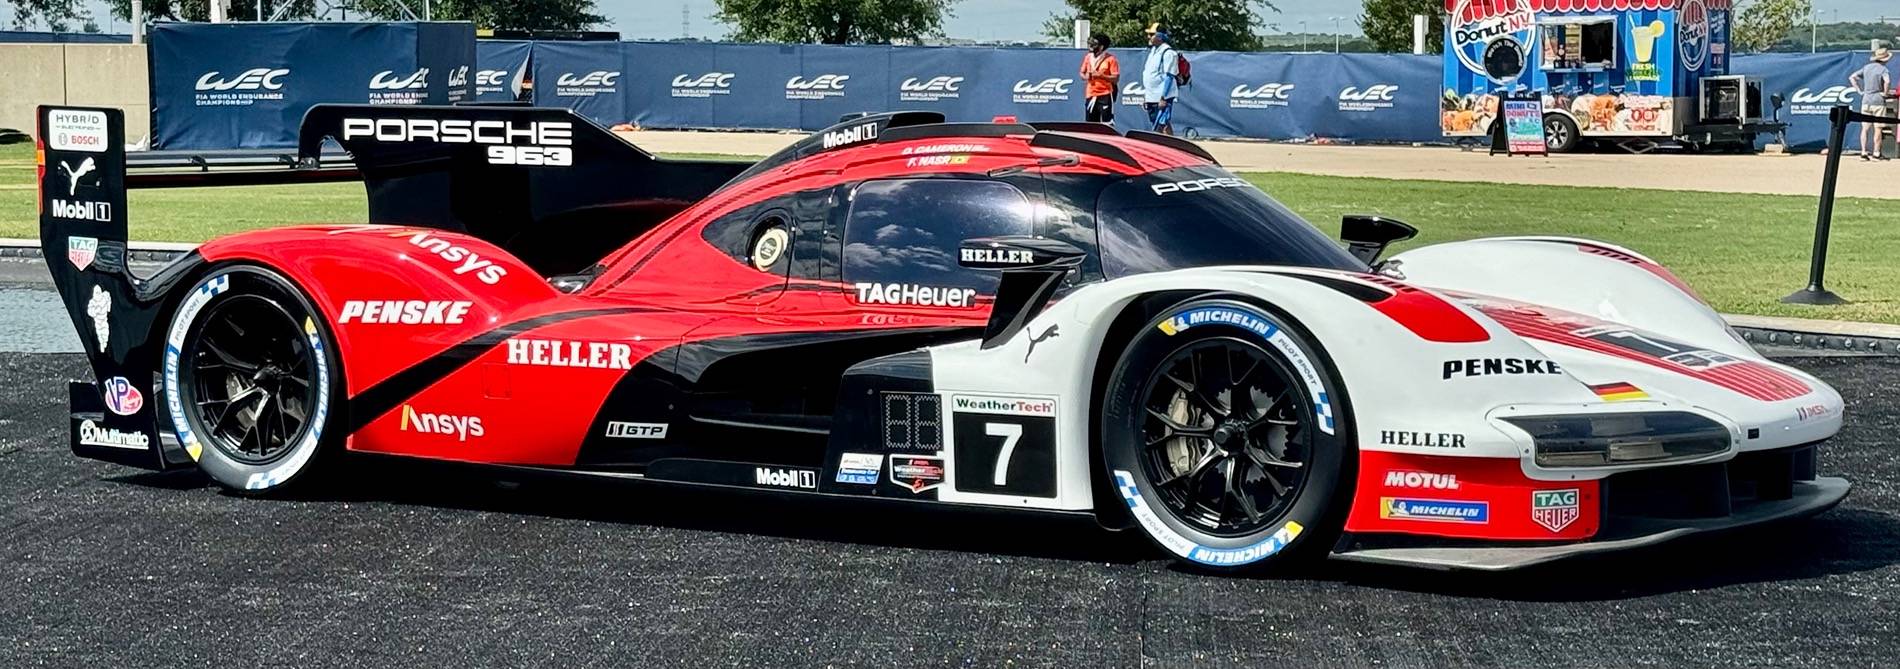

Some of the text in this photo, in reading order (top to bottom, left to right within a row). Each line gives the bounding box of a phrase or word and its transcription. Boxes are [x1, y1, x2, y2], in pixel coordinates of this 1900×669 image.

[1456, 22, 1508, 45] Donut
[195, 68, 290, 91] WEC
[475, 70, 508, 85] EC
[557, 71, 621, 86] WEC
[672, 72, 735, 87] WEC
[786, 74, 850, 90] WEC
[900, 76, 964, 91] WEC
[1013, 78, 1074, 94] WEC
[1230, 83, 1295, 99] WEC
[1339, 84, 1399, 100] WEC
[1791, 86, 1857, 103] WEC
[56, 114, 99, 124] HYBRID
[71, 135, 99, 145] BOSCH
[343, 118, 573, 146] PORSCHE
[823, 126, 862, 149] Mobil
[488, 146, 573, 166] 963
[53, 199, 94, 220] Mobil
[72, 240, 95, 250] TAG
[389, 231, 508, 285] Ansys
[960, 248, 1034, 264] HELLER
[338, 300, 474, 324] PENSKE
[1190, 310, 1270, 336] MICHELIN
[507, 338, 632, 370] HELLER
[1278, 338, 1318, 385] PILOT SPORT
[1443, 358, 1562, 380] PENSKE
[166, 351, 188, 433] MICHELIN
[956, 398, 1053, 413] WeatherTech
[400, 404, 485, 441] Ansys
[626, 425, 664, 436] GTP
[96, 426, 149, 447] Multimatic
[1381, 430, 1466, 449] HELLER
[985, 422, 1023, 486] 7
[756, 467, 798, 487] Mobil
[1384, 471, 1460, 490] MOTUL
[1539, 492, 1576, 506] TAG
[1410, 504, 1480, 517] MICHELIN
[1535, 507, 1576, 528] HEUER
[1195, 539, 1276, 564] MICHELIN
